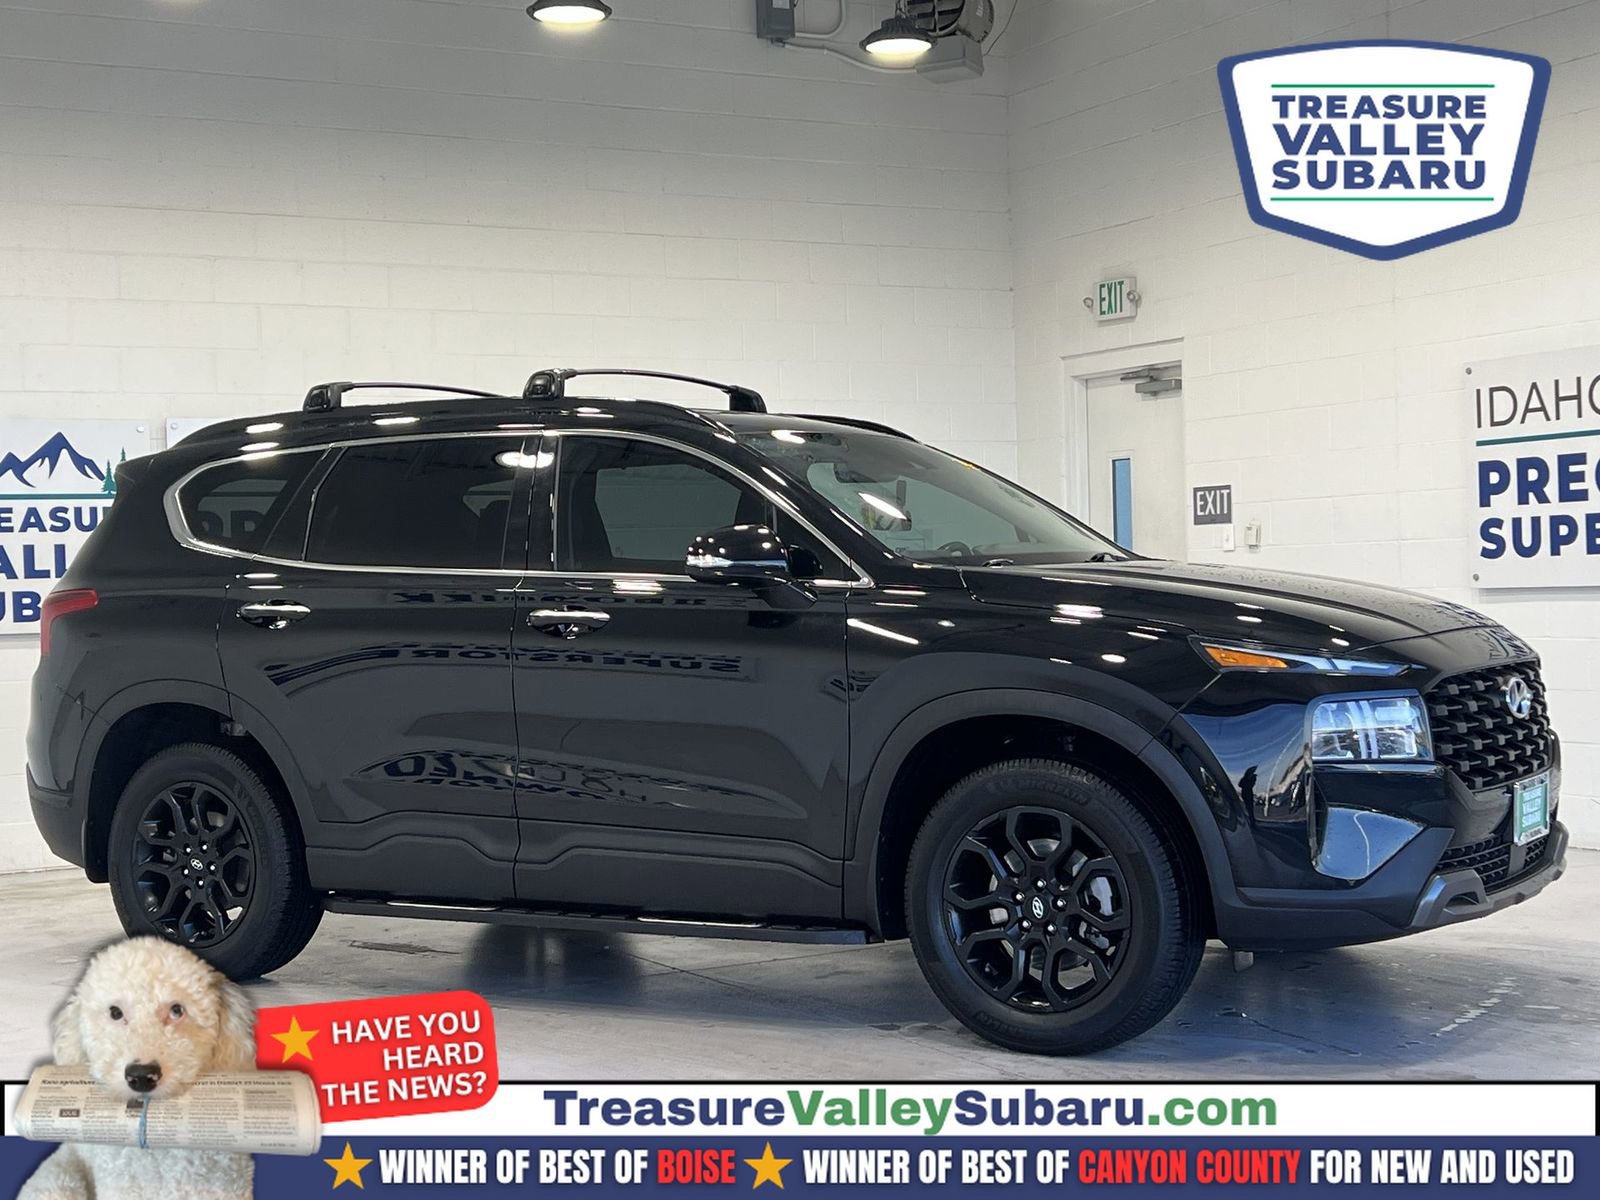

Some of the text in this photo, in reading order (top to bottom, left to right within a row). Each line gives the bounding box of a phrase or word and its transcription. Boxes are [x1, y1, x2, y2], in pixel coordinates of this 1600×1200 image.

[1099, 281, 1125, 316] EXIT
[1478, 452, 1600, 508] PRE
[1196, 489, 1230, 516] EXIT
[0, 506, 112, 533] EASU
